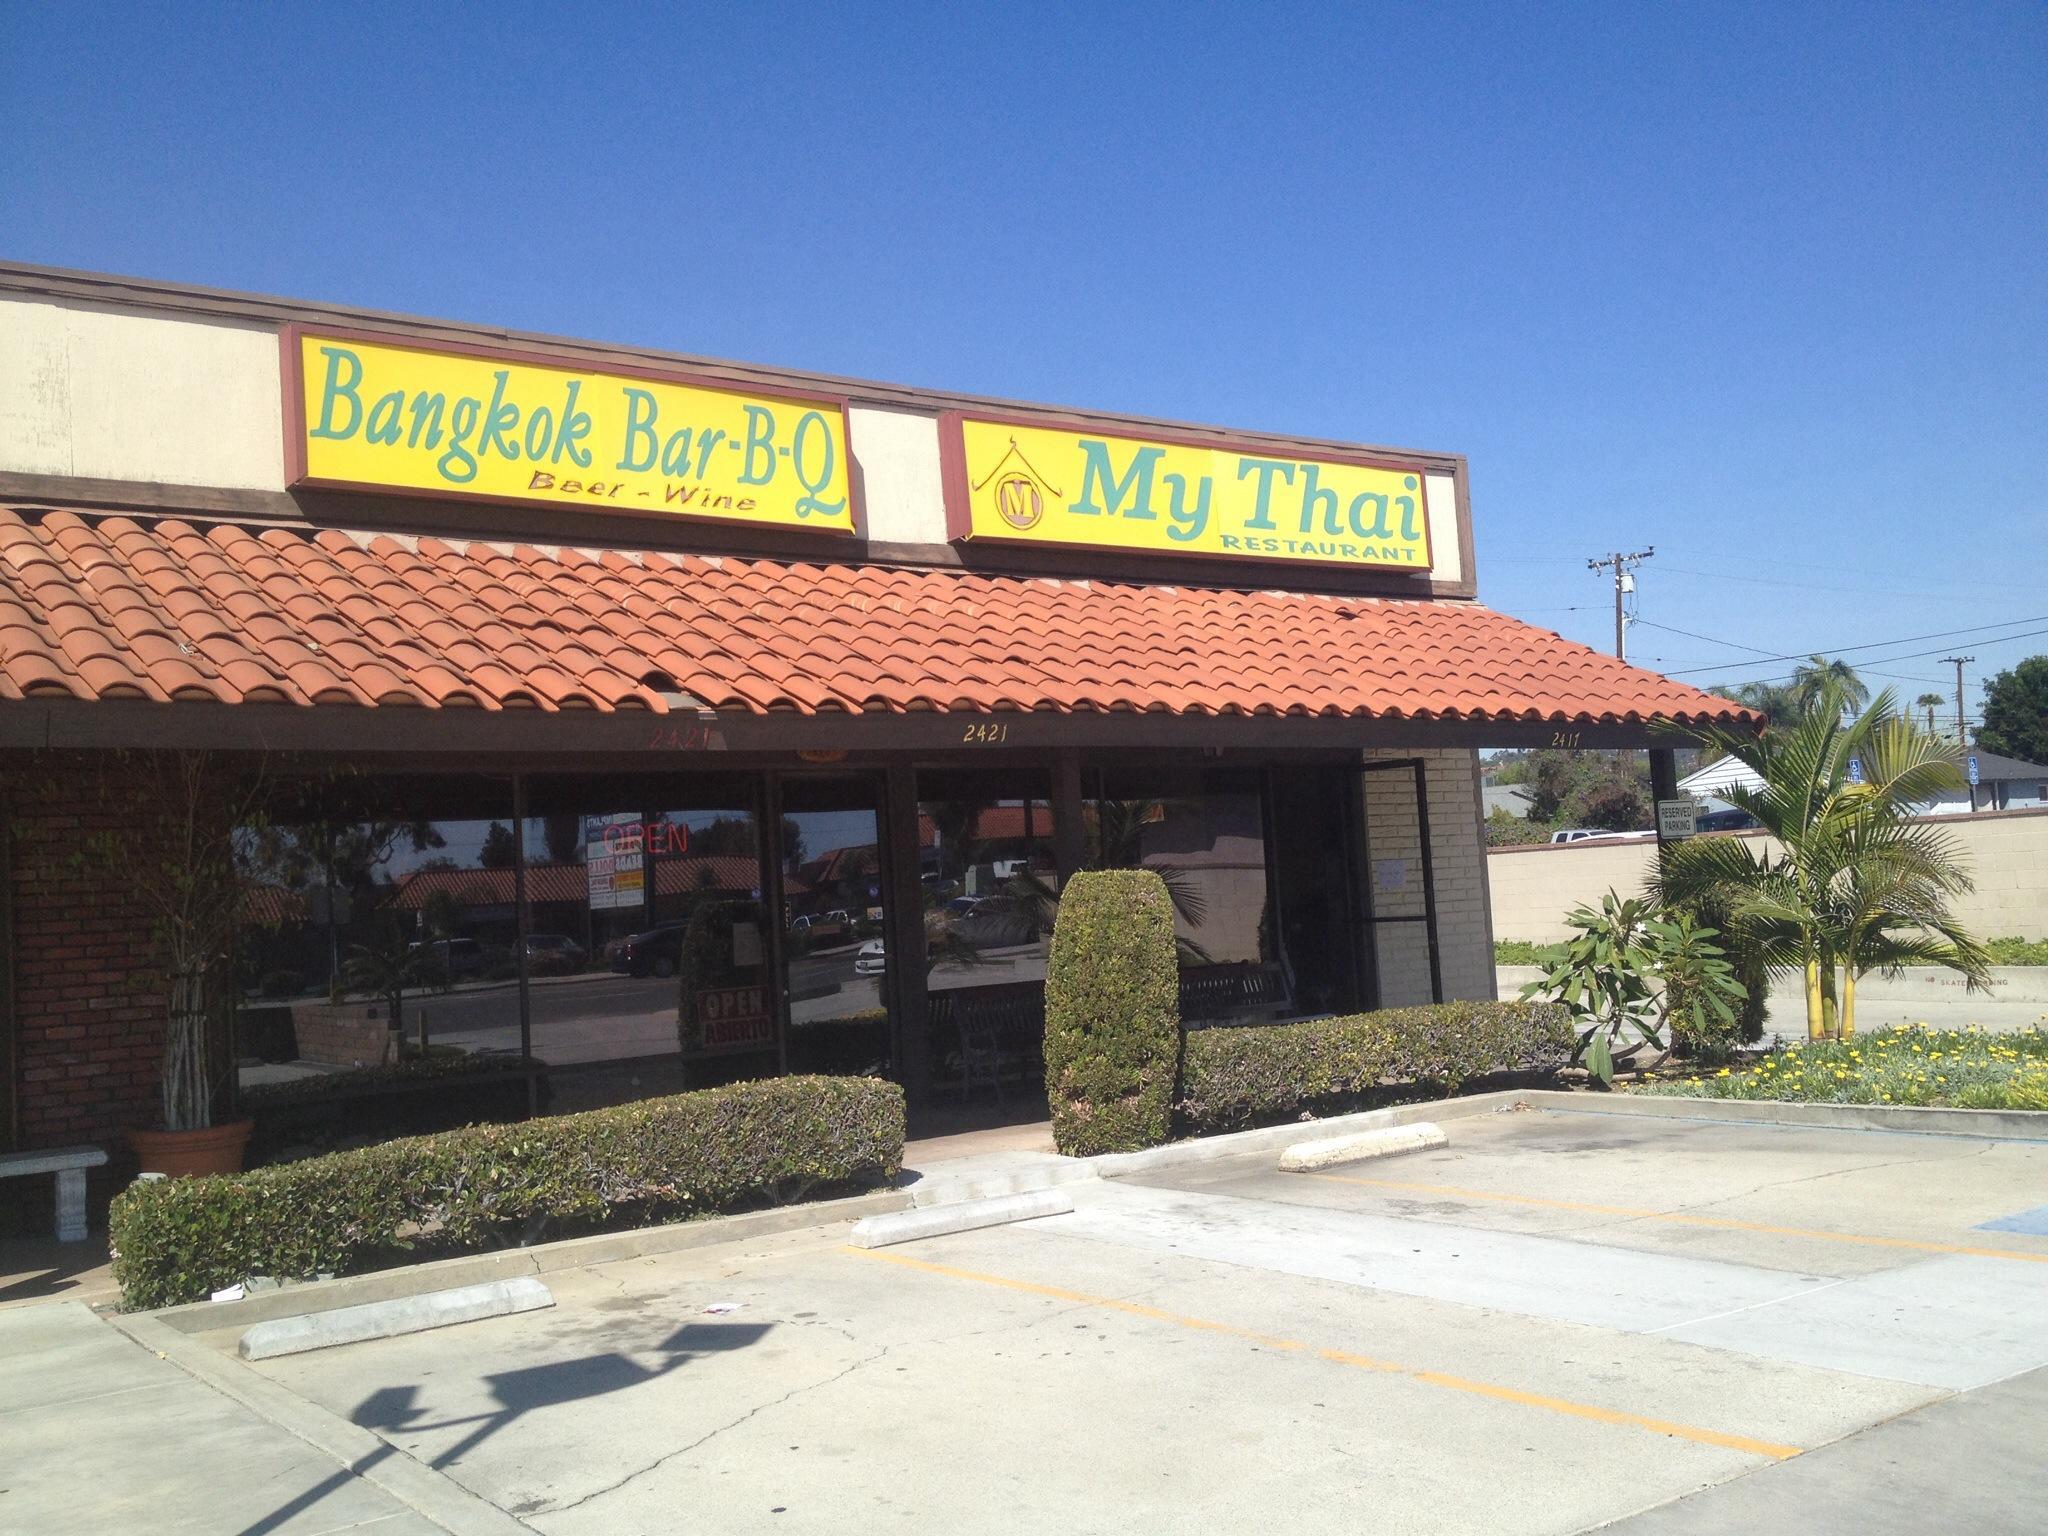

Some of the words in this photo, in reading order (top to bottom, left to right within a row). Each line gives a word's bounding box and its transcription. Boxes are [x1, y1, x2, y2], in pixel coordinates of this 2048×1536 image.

[310, 347, 592, 483] Bangkok
[616, 387, 847, 518] Bar-B-Q
[528, 470, 625, 498] Beer
[664, 483, 757, 511] Wine
[1003, 482, 1035, 518] M
[1067, 440, 1213, 542] My
[1237, 458, 1421, 541] Thai
[1220, 534, 1416, 562] RESTAURANT
[963, 723, 1008, 742] 2421
[1661, 806, 1692, 818] RESERVED
[1664, 819, 1691, 832] PARKING
[603, 823, 689, 854] OPEN
[706, 986, 764, 1018] OPEN
